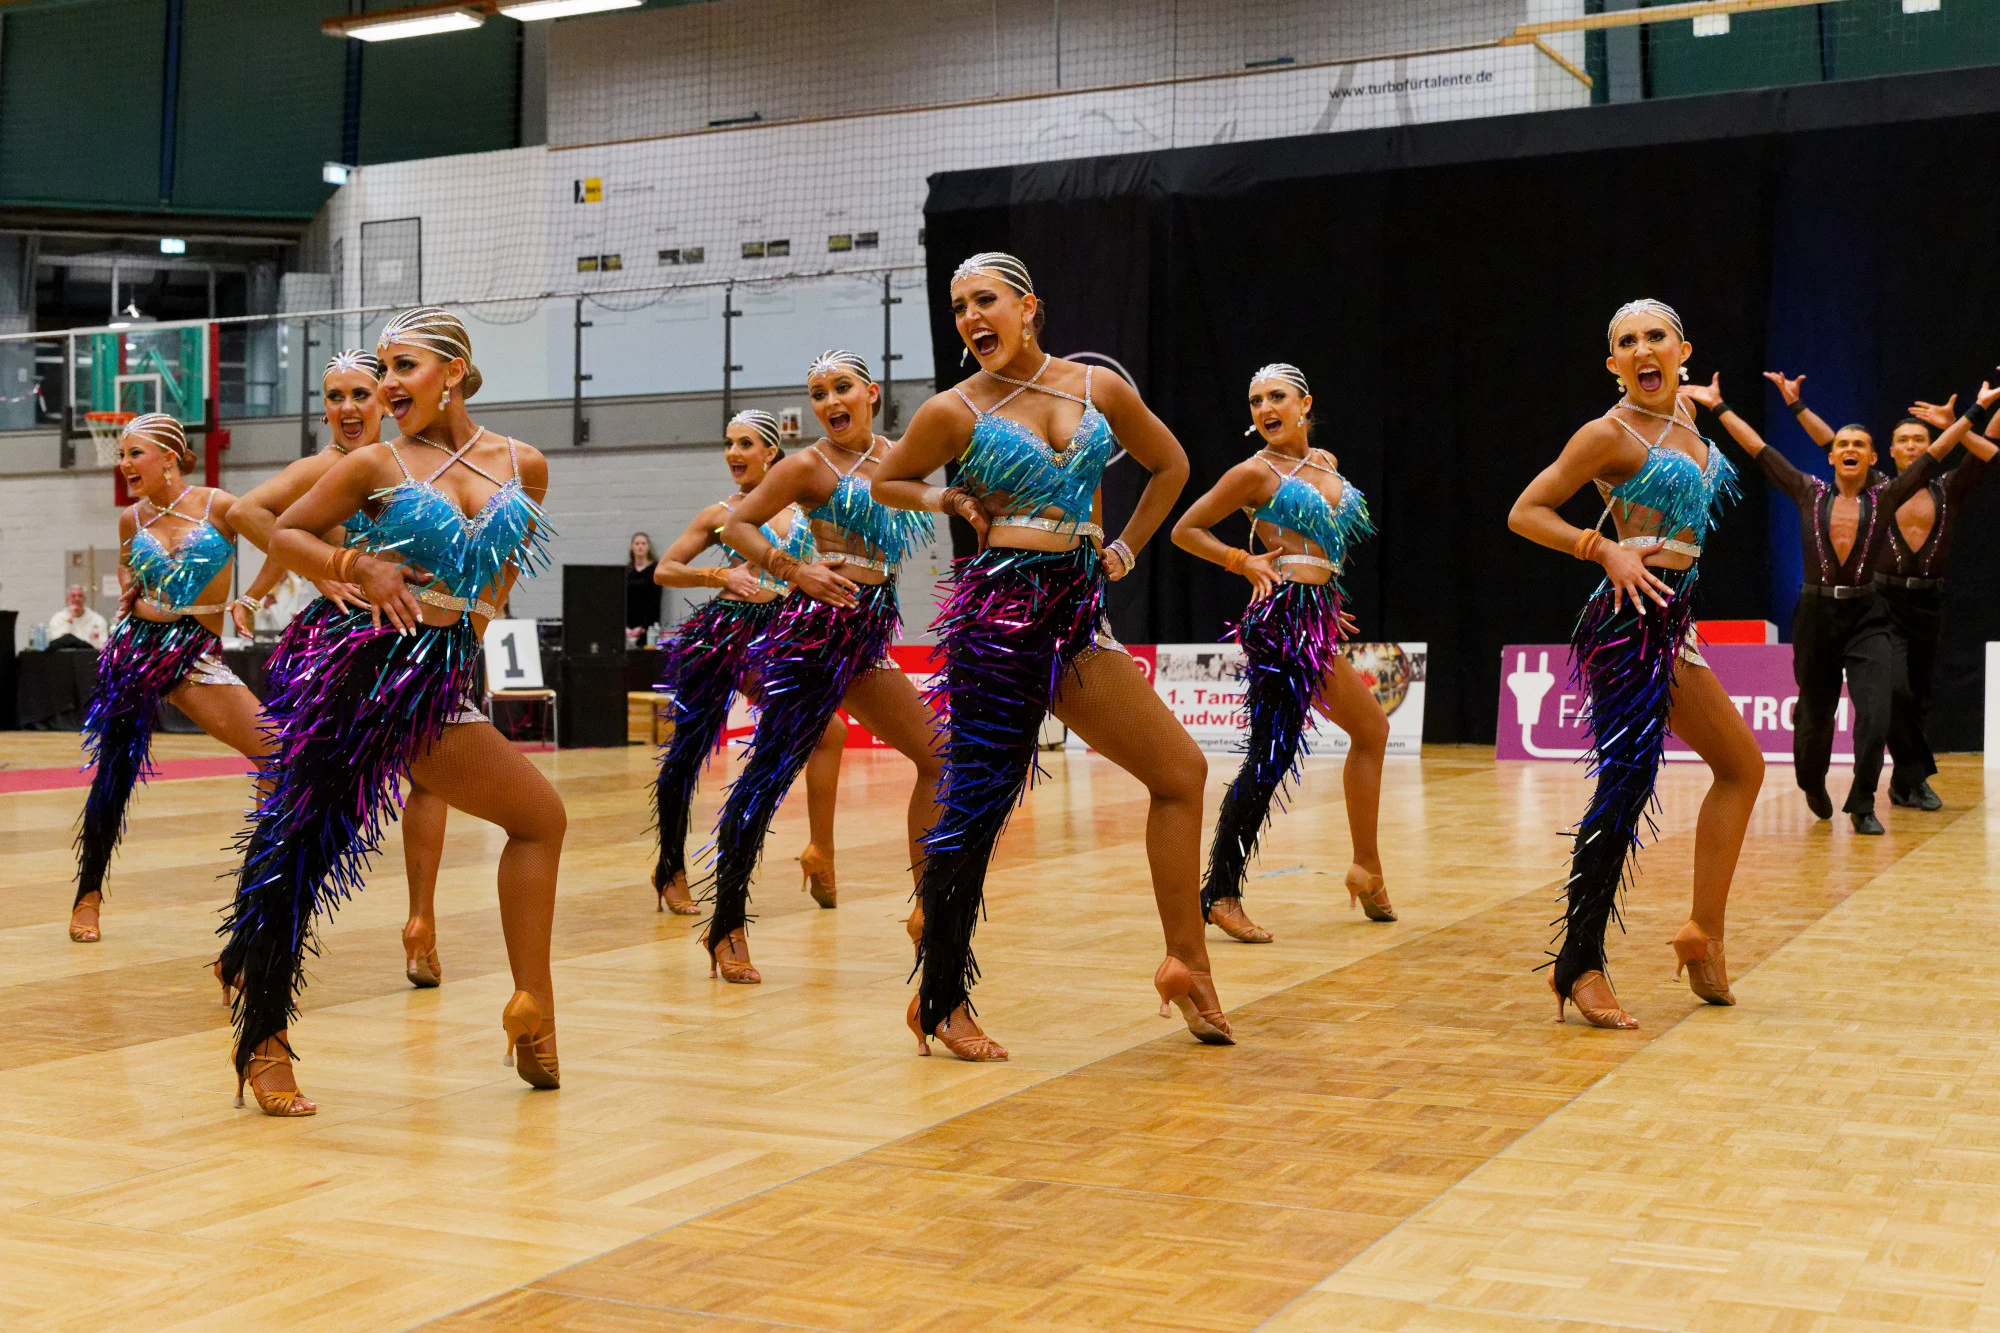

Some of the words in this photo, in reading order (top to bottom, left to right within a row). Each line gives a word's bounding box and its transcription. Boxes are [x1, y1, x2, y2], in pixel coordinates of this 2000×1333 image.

[501, 632, 525, 678] 1
[1168, 689, 1184, 704] 1.
[1170, 710, 1249, 729] udwig
